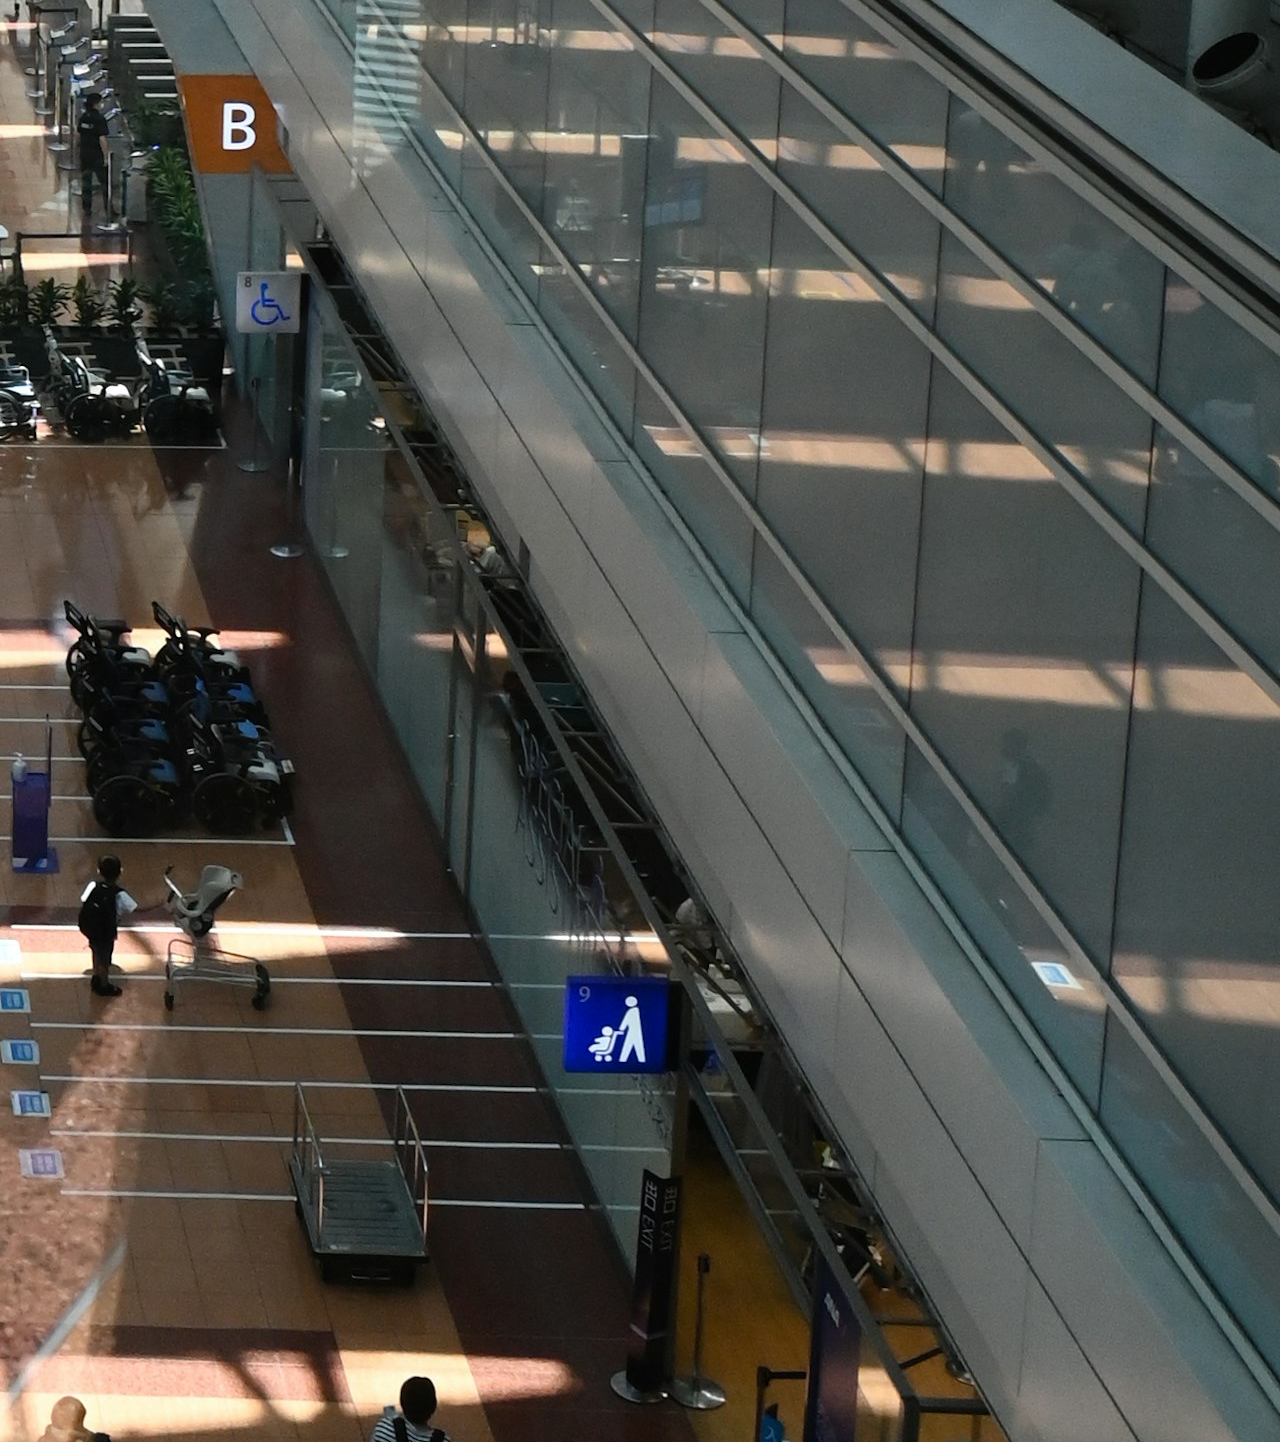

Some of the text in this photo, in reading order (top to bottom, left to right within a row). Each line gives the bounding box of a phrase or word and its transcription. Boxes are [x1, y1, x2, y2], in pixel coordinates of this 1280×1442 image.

[222, 102, 257, 150] B
[244, 276, 253, 288] 8
[579, 986, 591, 1003] 9
